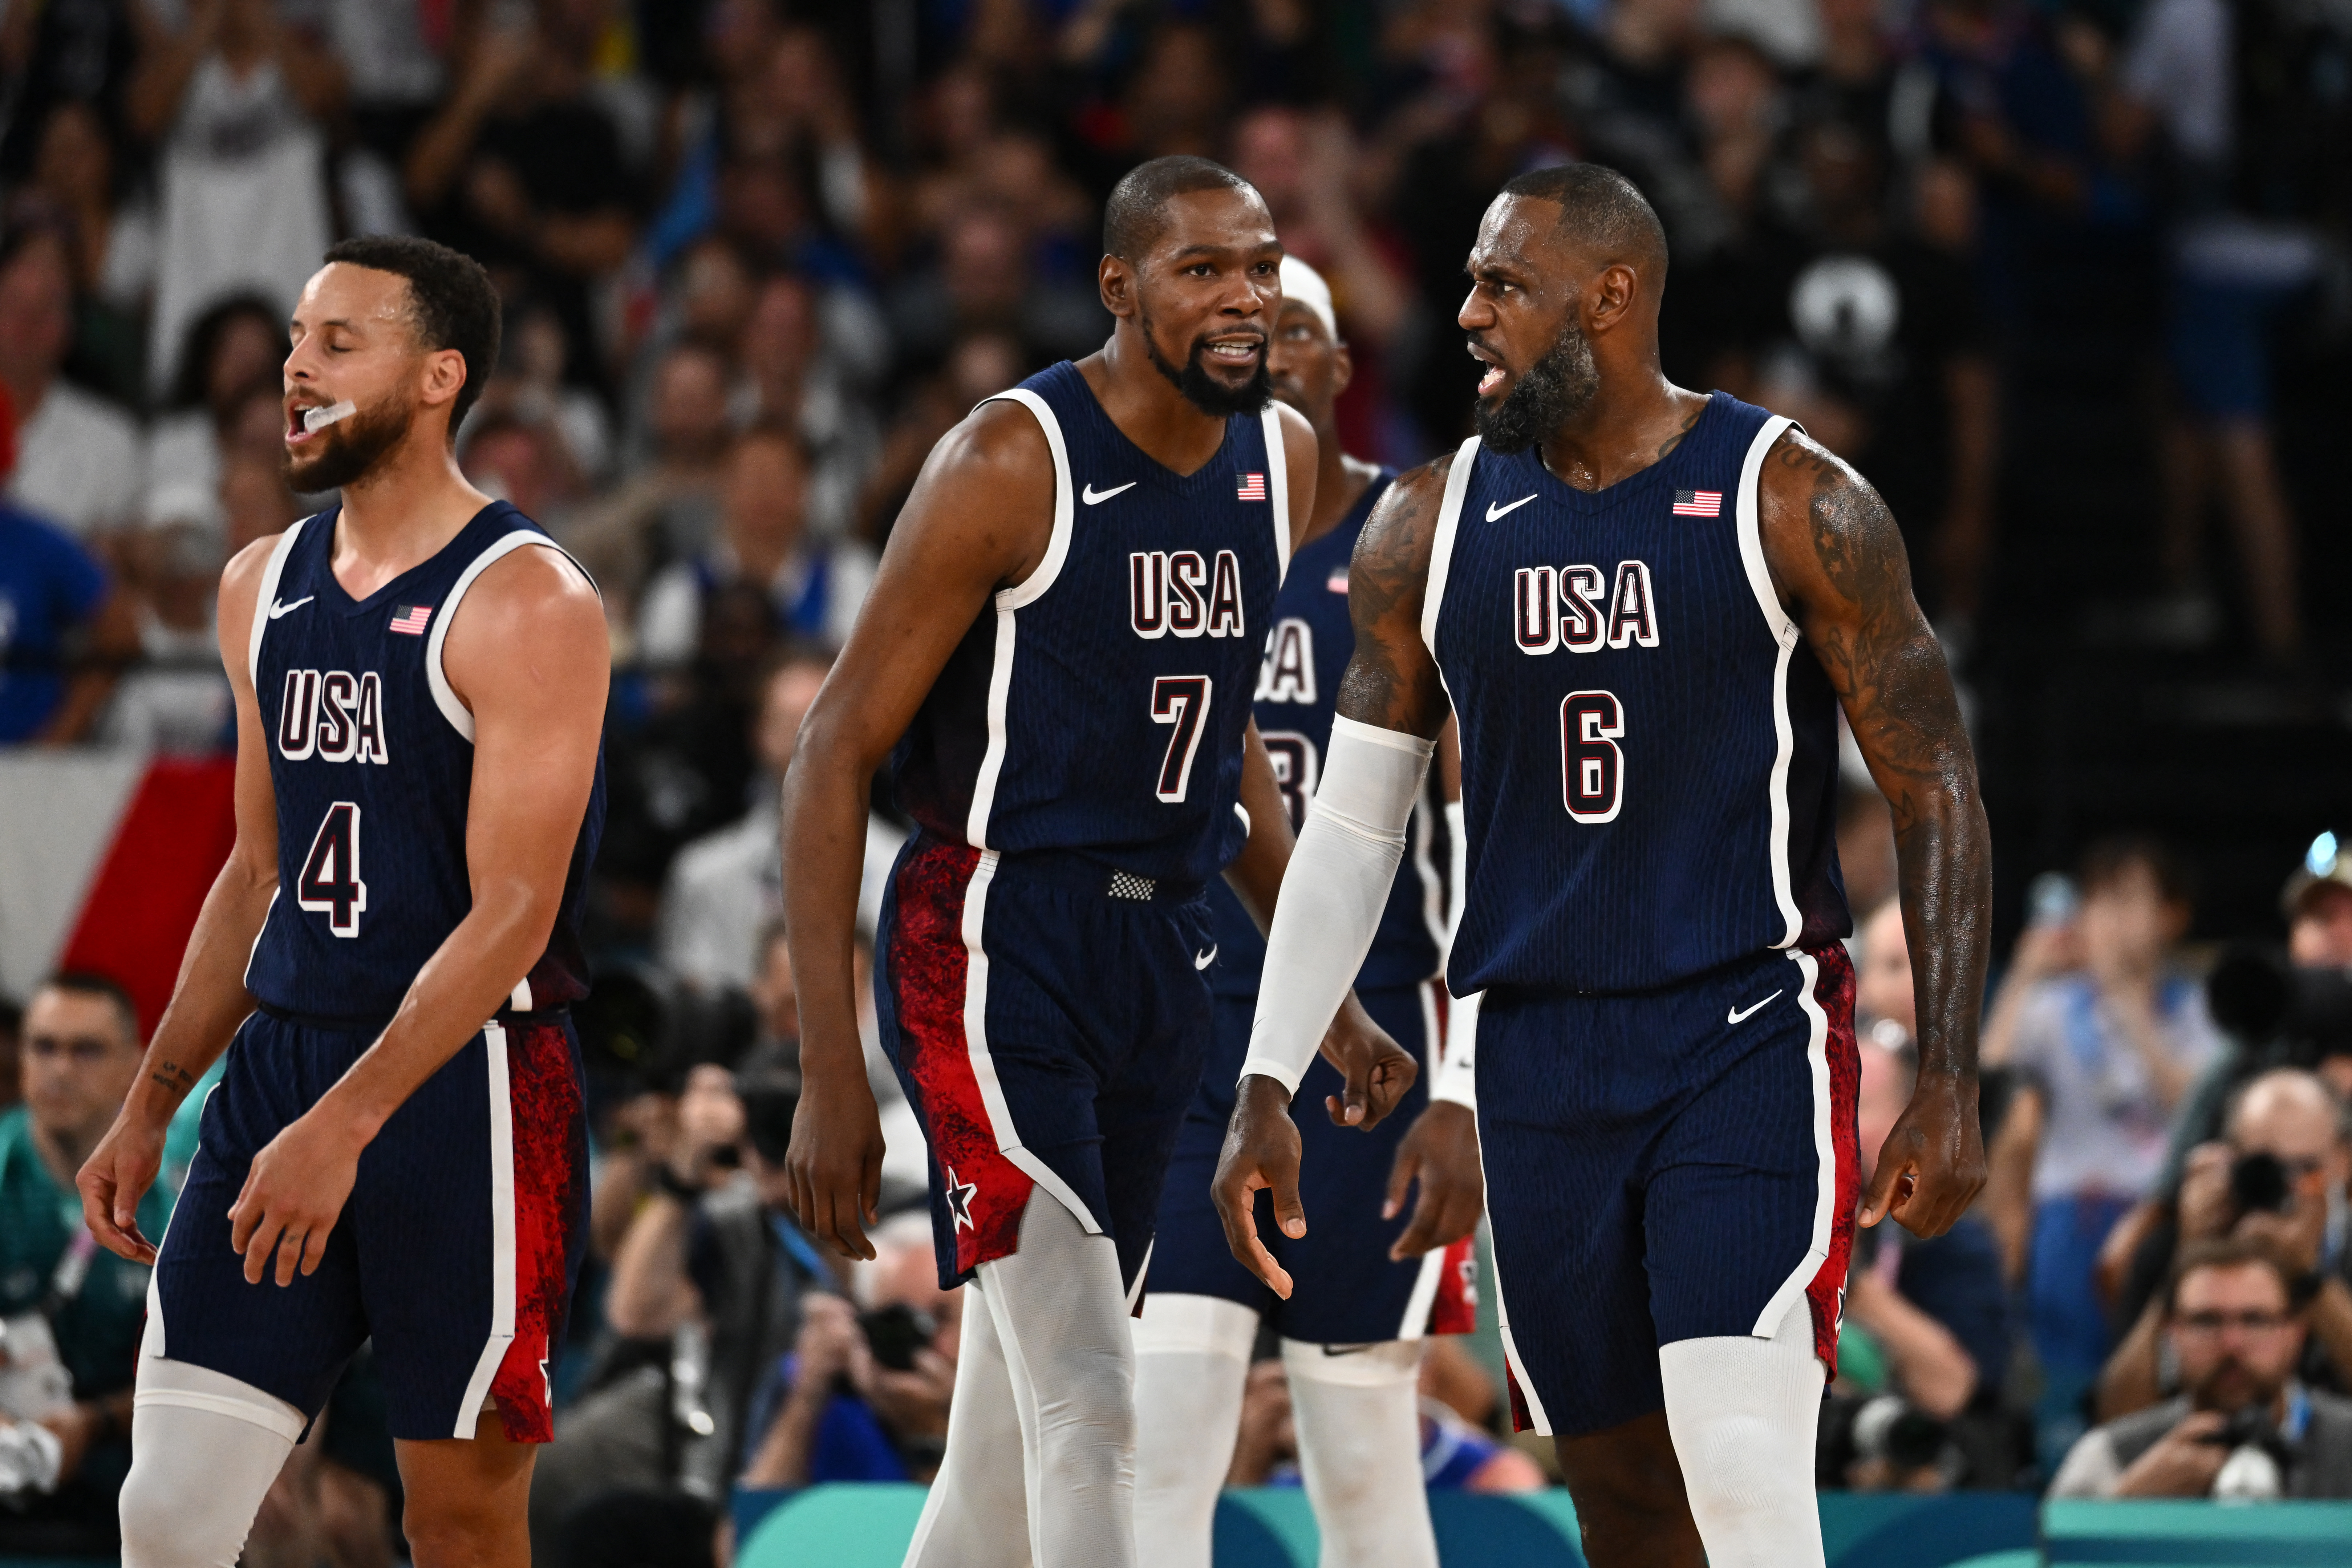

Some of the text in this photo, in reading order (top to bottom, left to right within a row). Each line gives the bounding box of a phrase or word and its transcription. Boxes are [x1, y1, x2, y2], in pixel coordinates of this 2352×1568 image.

[1130, 550, 1245, 639] USA
[1514, 560, 1660, 656] USA
[278, 669, 389, 765] USA
[1150, 674, 1213, 803] 7
[1560, 690, 1625, 824] 6
[297, 801, 367, 938] 4
